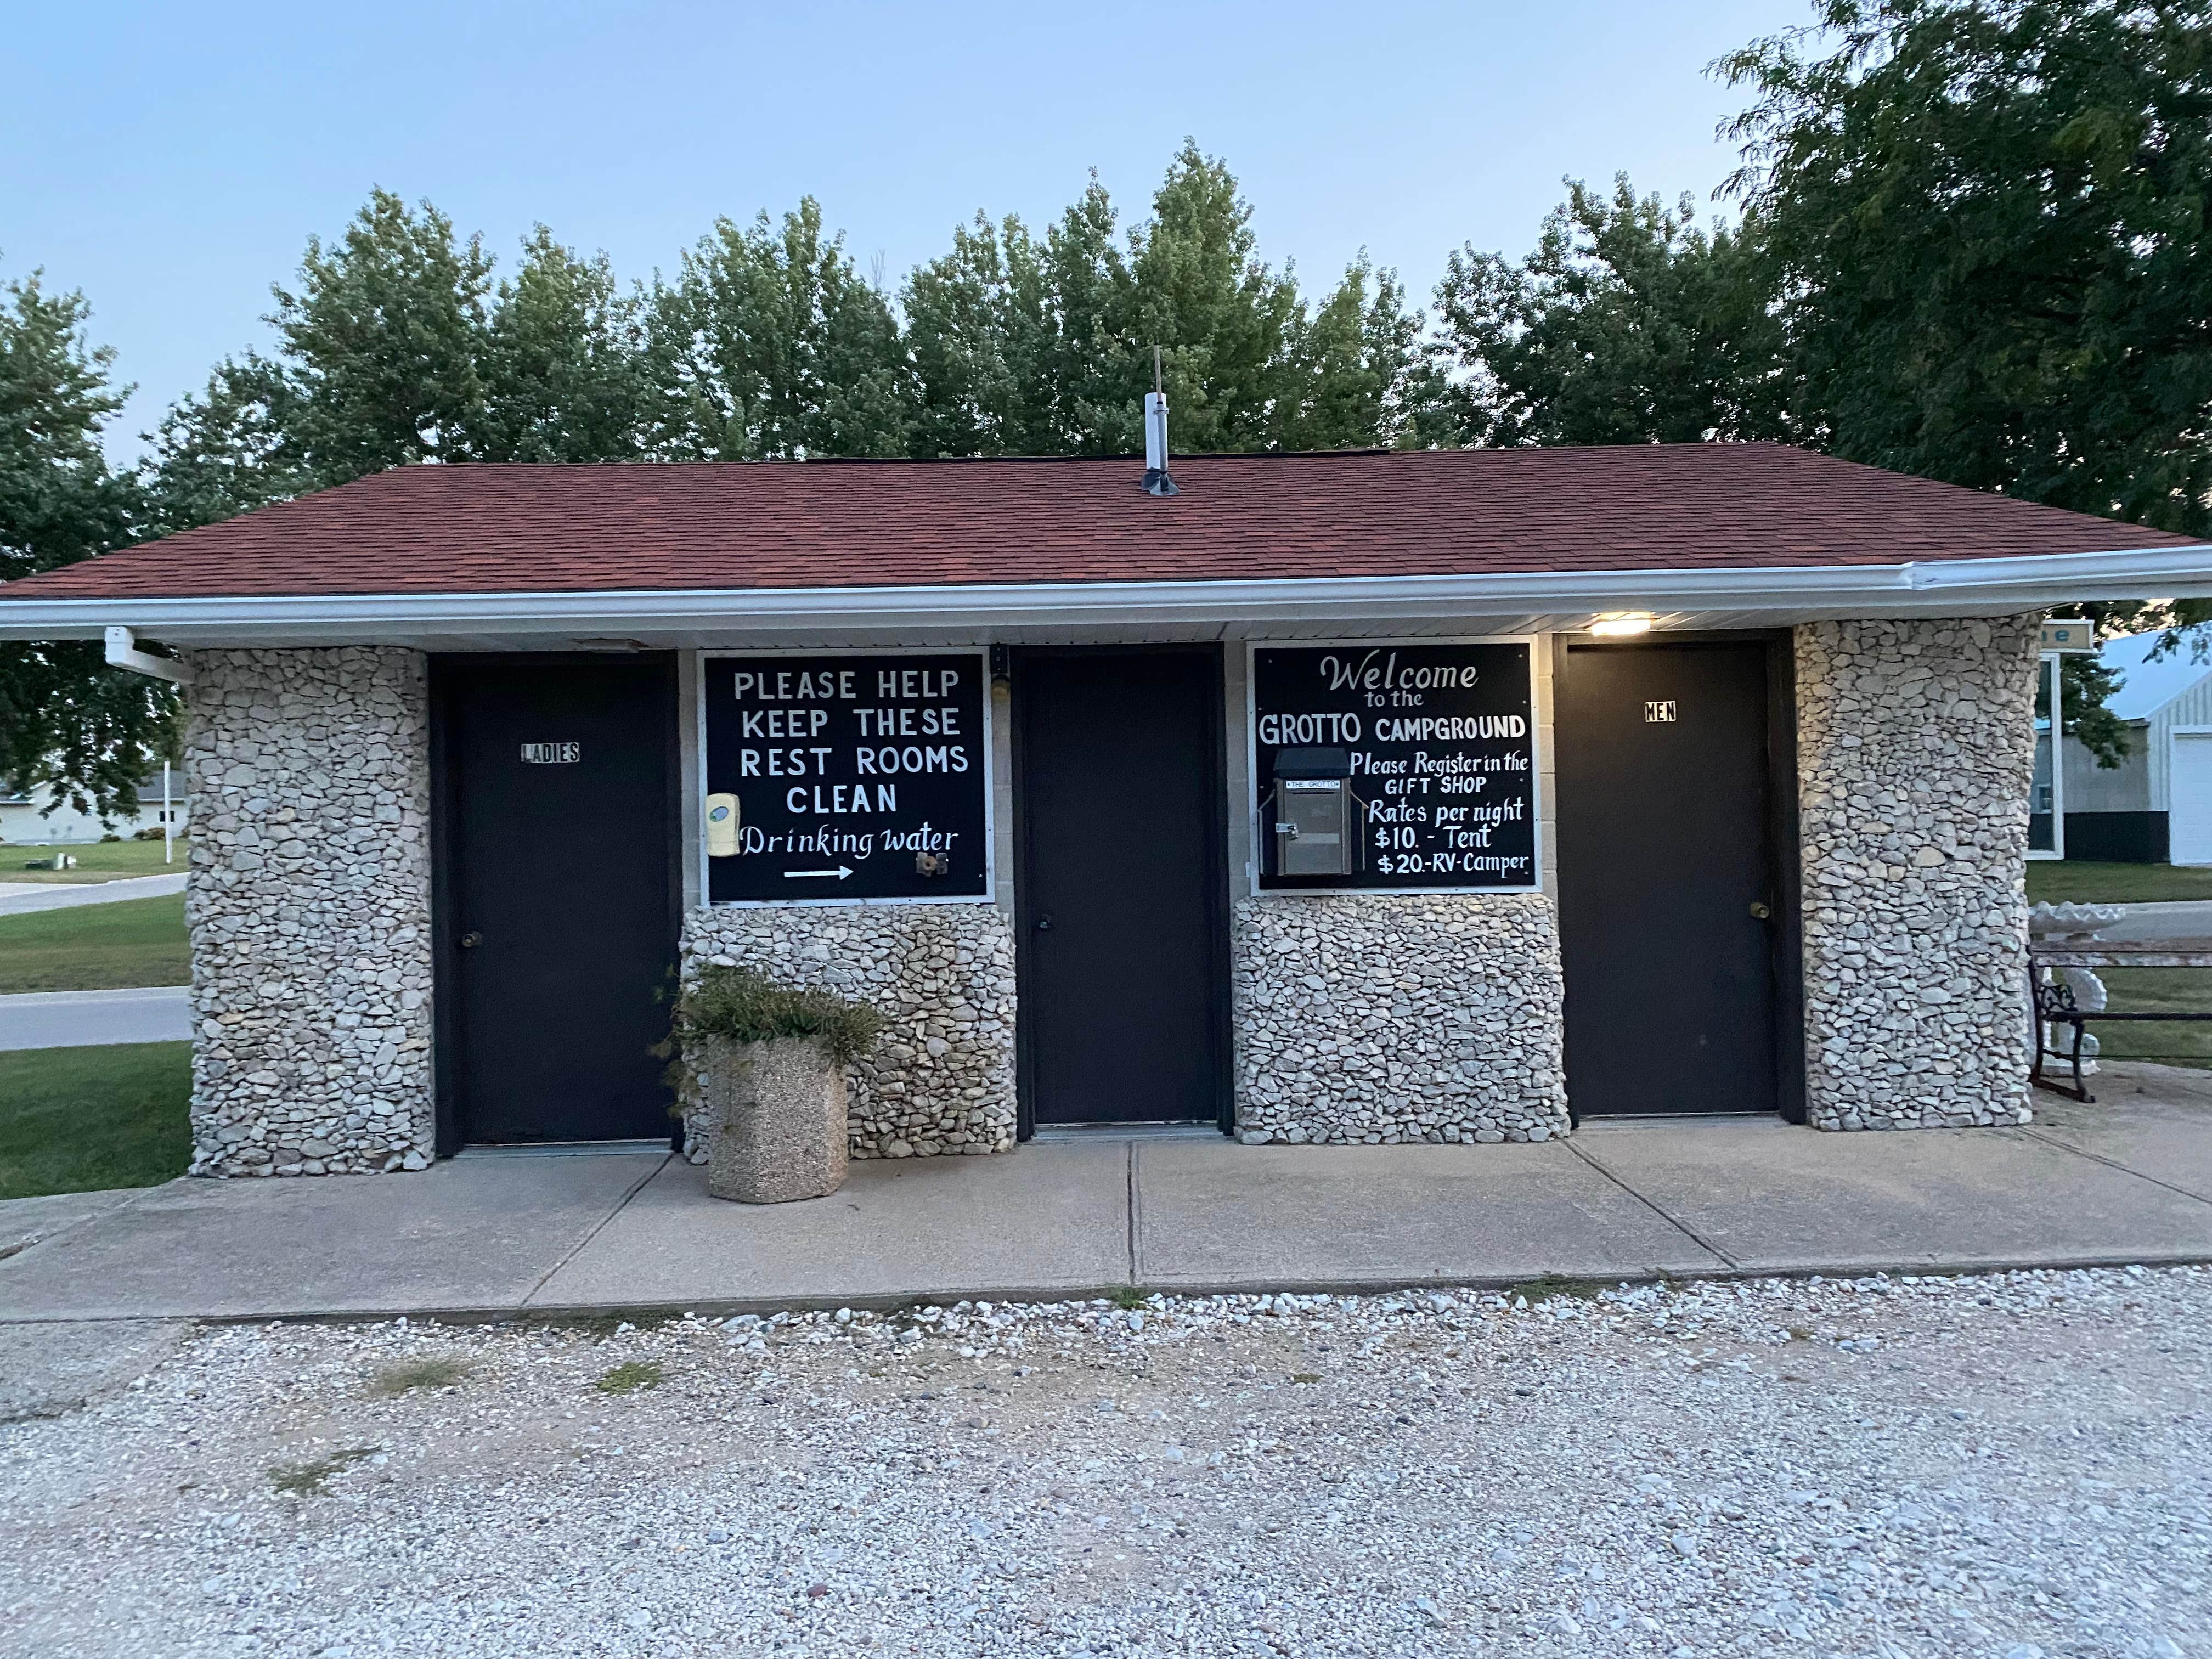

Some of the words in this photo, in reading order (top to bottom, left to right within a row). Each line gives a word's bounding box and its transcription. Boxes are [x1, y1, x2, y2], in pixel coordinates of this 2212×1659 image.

[1320, 649, 1479, 690] Welcome
[734, 672, 856, 700] PLEASE
[878, 670, 959, 698] HELP
[1364, 691, 1386, 707] to
[1390, 690, 1425, 707] the
[742, 710, 828, 738] KEEP
[853, 708, 960, 736] THESE
[1646, 702, 1675, 721] MEN
[1259, 713, 1362, 744] GROTTO
[1375, 715, 1526, 742] CAMPGROUND
[523, 743, 578, 763] LADIES
[741, 748, 832, 776] REST
[856, 746, 968, 774] ROOMS
[1350, 752, 1407, 775] Please
[1414, 751, 1482, 777] Register
[1484, 754, 1501, 771] in
[1503, 750, 1529, 771] the
[787, 784, 896, 814] CLEAN
[1385, 777, 1431, 794] GIFT
[1440, 775, 1487, 793] SHOP
[1368, 797, 1427, 823] Rates
[1435, 806, 1469, 828] per
[1473, 796, 1525, 827] night
[740, 824, 874, 859] Drinking
[879, 821, 959, 851] water
[1375, 826, 1420, 850] $10.
[1442, 823, 1493, 849] Tent
